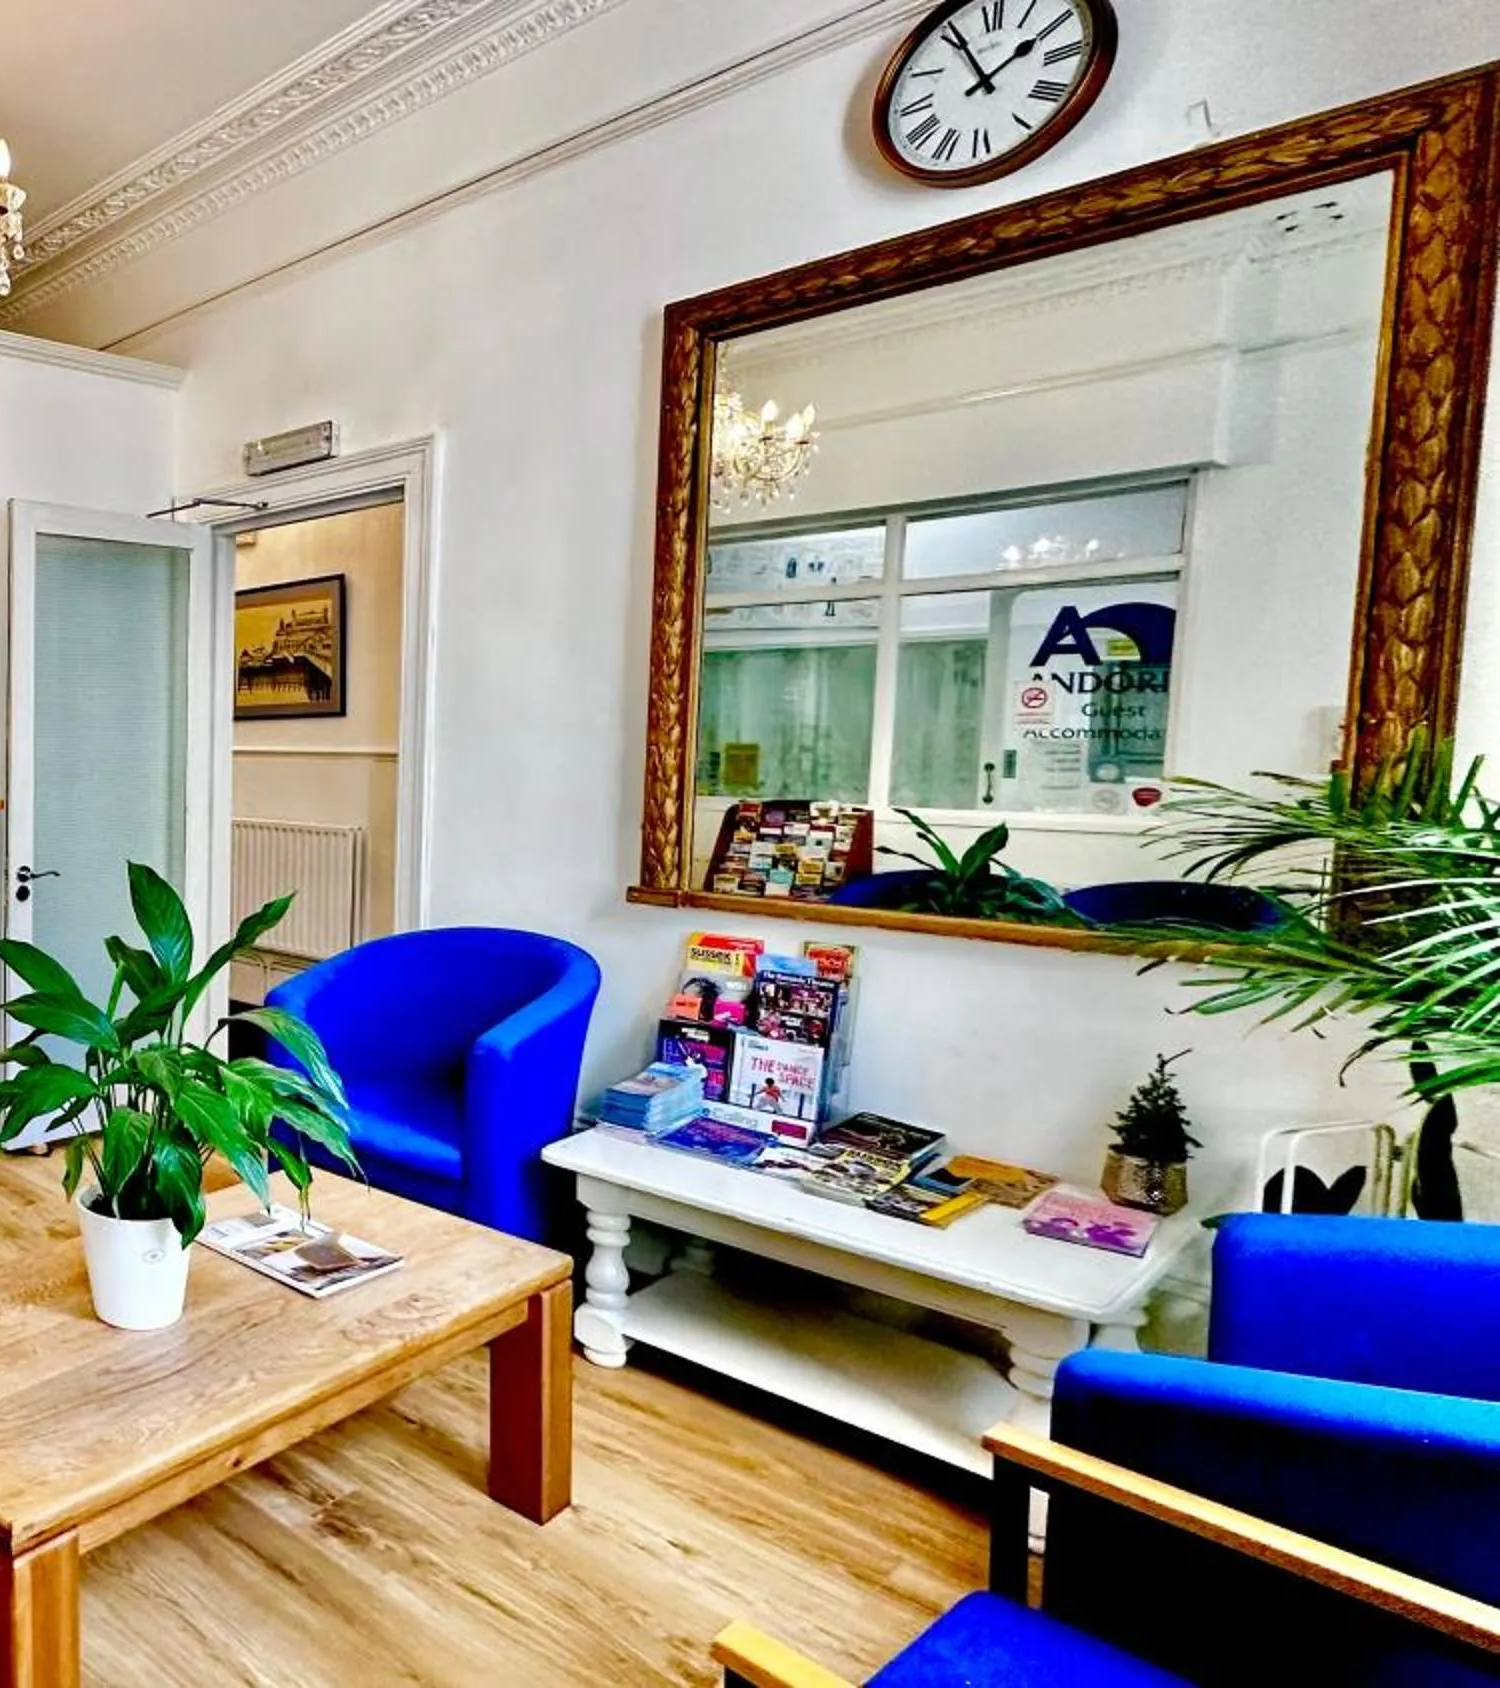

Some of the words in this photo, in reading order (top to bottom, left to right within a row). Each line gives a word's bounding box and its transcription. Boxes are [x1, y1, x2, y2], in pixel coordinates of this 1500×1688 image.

[1081, 703, 1147, 717] Guest
[1023, 727, 1166, 741] Accommoda
[750, 1056, 776, 1074] THE
